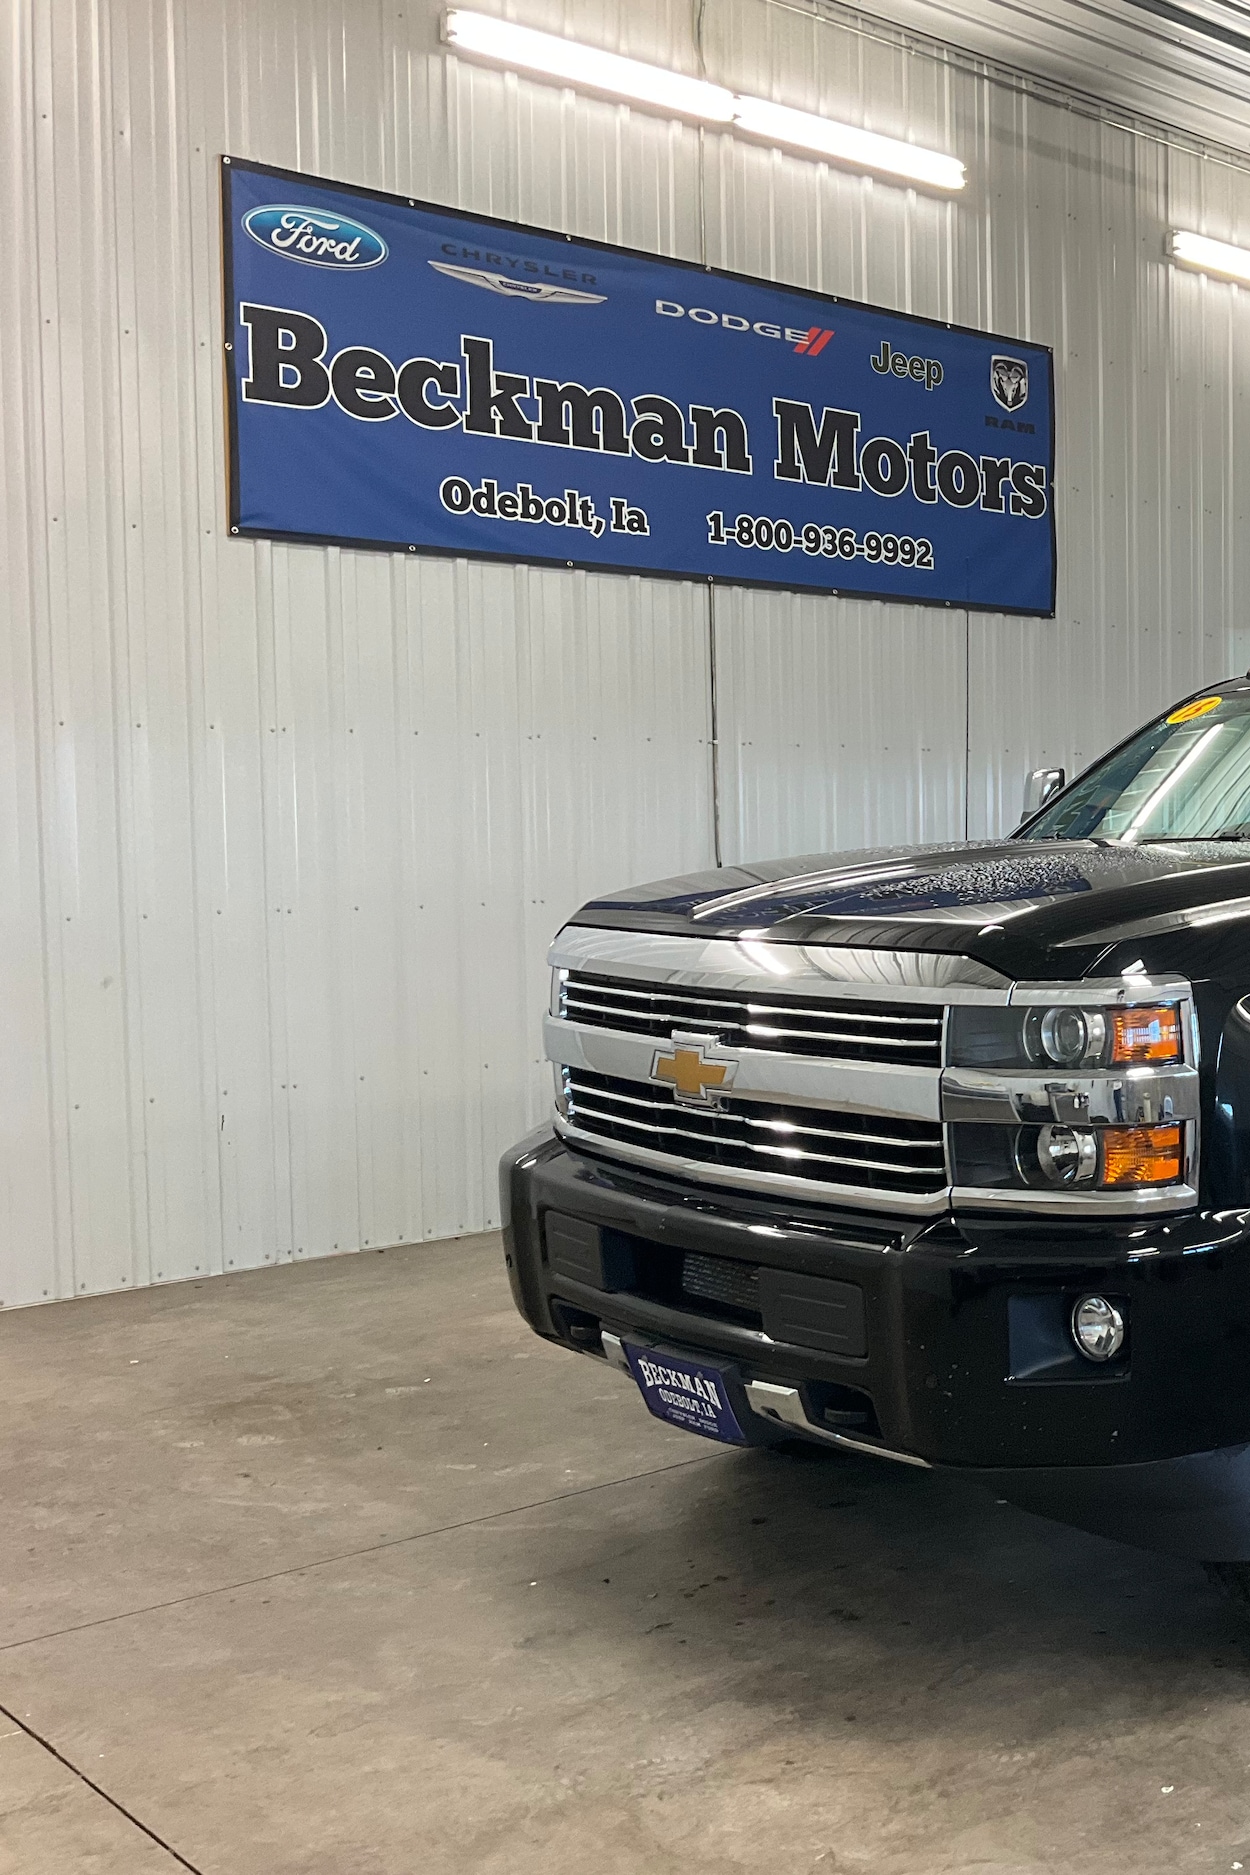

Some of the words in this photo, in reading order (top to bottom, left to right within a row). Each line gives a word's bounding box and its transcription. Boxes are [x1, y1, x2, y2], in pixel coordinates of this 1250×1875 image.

[270, 212, 361, 262] Ford
[441, 242, 598, 285] CHRYSLER
[655, 300, 809, 343] DODGE
[870, 341, 944, 390] Jeep
[240, 301, 752, 475] Beckman
[773, 397, 1047, 519] Motors
[985, 415, 1035, 434] RAM
[440, 476, 606, 538] Odebolt,
[610, 497, 650, 536] Ia
[707, 511, 934, 570] 1-800-936-9992
[638, 1358, 722, 1411] BECKMAN
[659, 1388, 704, 1416] ODEBOLT,
[701, 1402, 717, 1419] IA
